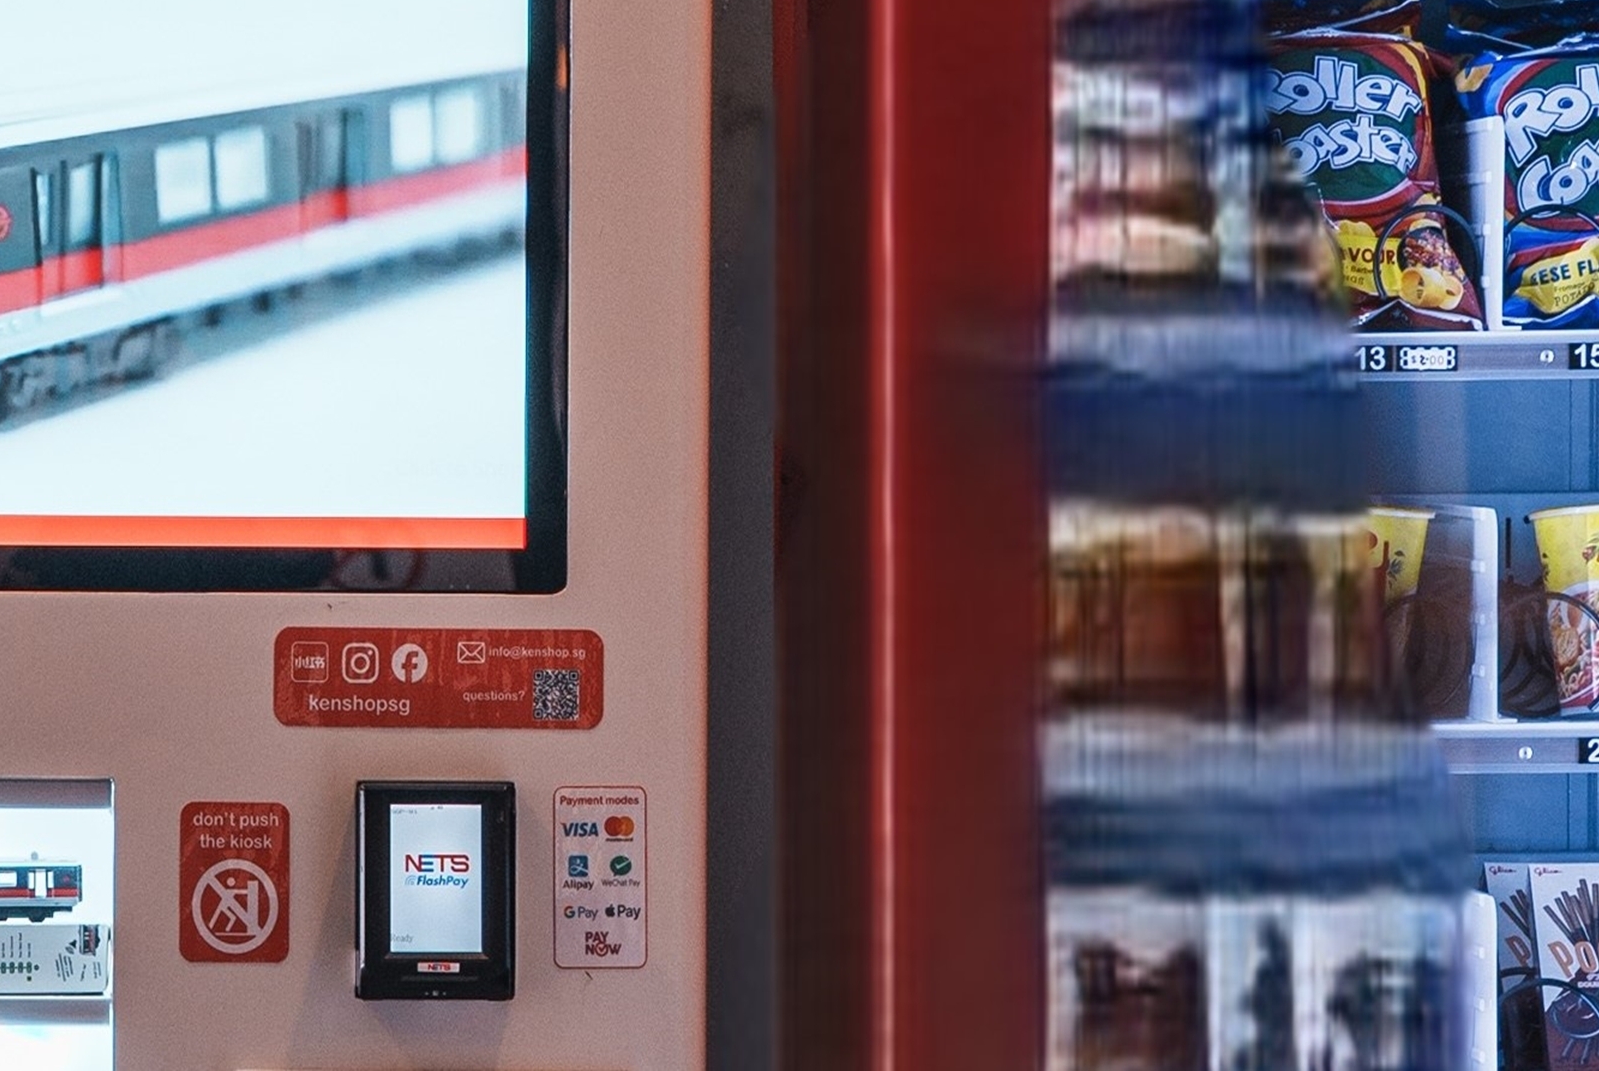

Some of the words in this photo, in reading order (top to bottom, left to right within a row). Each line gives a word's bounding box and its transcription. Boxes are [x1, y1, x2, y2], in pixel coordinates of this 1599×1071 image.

[1354, 346, 1386, 371] 13
[488, 646, 587, 660] info@kenshop.sg
[462, 690, 525, 703] questions?
[308, 694, 411, 716] kenshopsg
[559, 795, 603, 808] Payment
[605, 795, 639, 806] modes
[193, 811, 236, 827] don't
[239, 812, 279, 830] push
[560, 822, 599, 837] VISA
[200, 834, 226, 849] the
[230, 834, 273, 849] kiosk
[405, 854, 470, 873] NETS
[416, 875, 469, 889] FlashPay
[562, 880, 594, 891] Alipay
[577, 906, 599, 921] Pay
[617, 904, 641, 921] Pay
[585, 931, 609, 943] PAY
[585, 943, 622, 957] NOW
